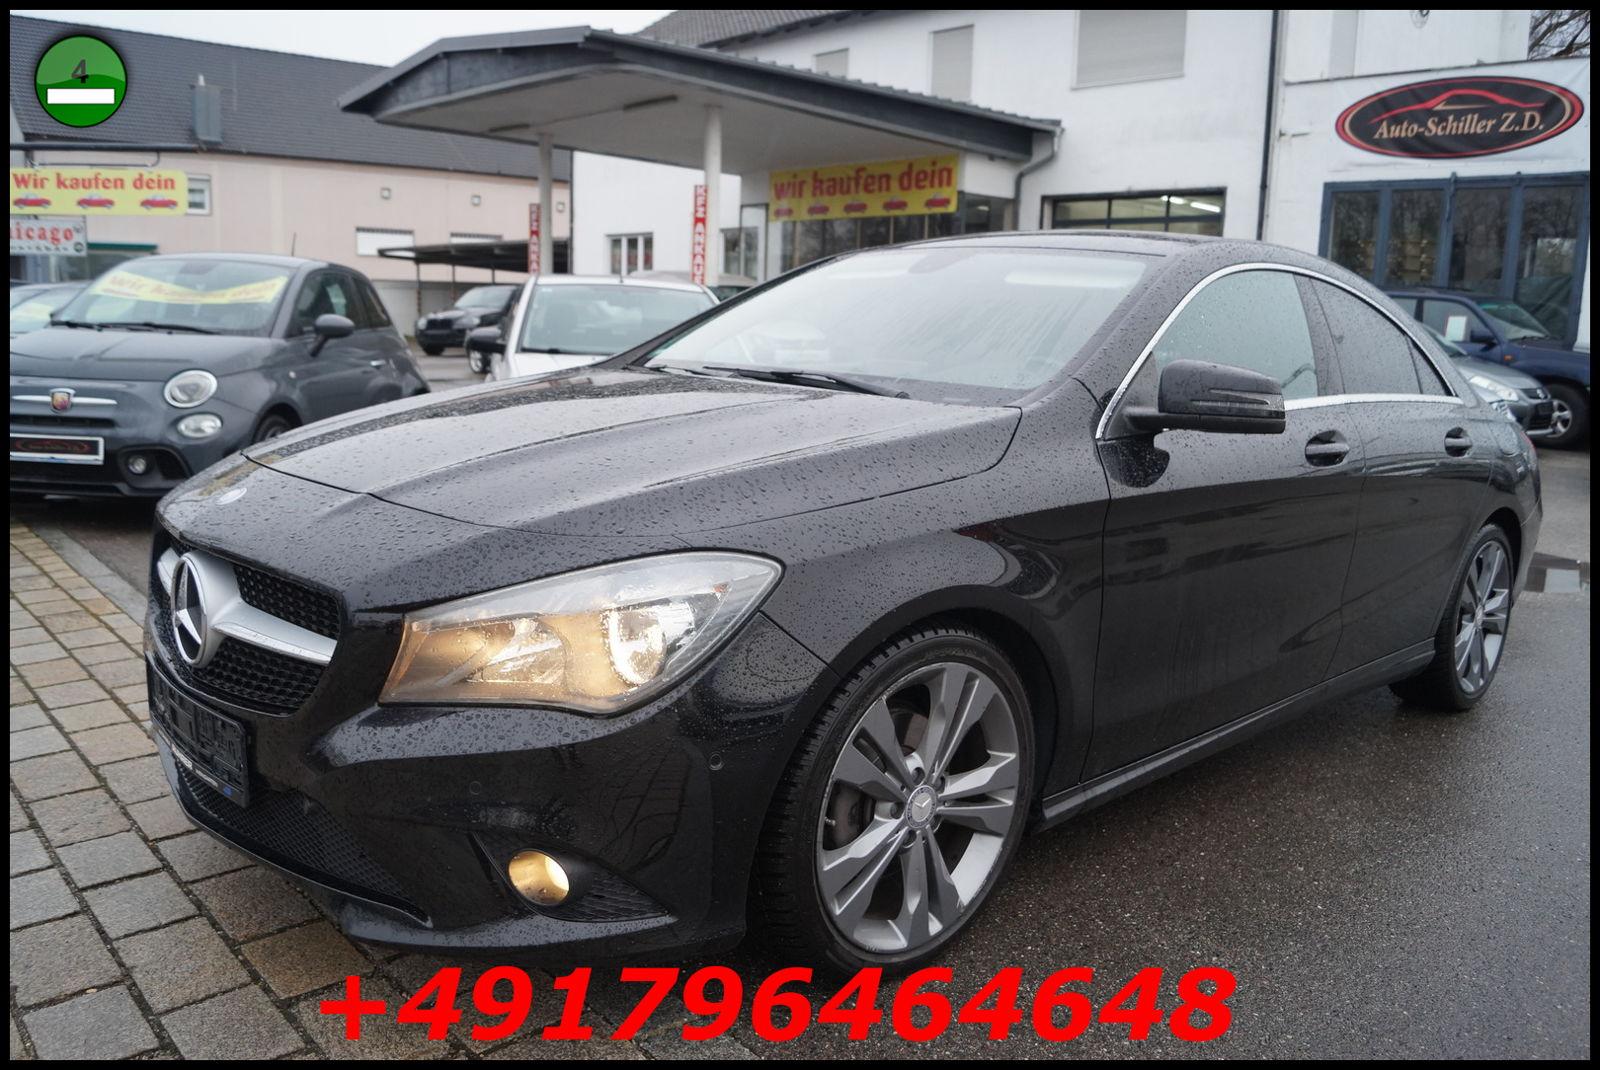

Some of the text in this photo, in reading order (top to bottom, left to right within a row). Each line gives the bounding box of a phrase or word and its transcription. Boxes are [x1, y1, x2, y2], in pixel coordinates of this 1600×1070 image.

[1373, 110, 1545, 140] Auto-Schiller Z.D.
[12, 171, 176, 190] Wir kaufen dein
[773, 160, 954, 201] wir kaufen dein
